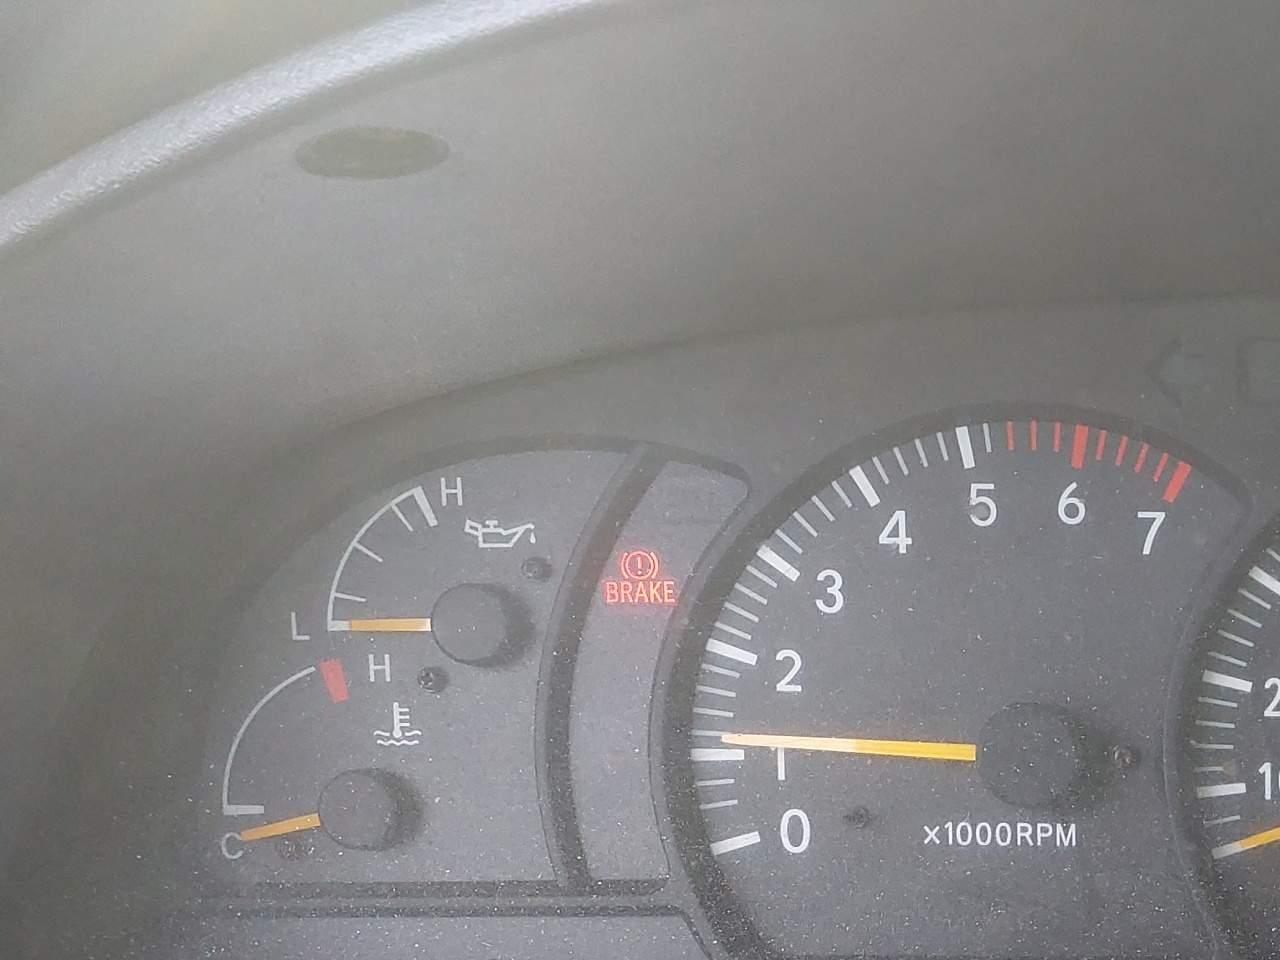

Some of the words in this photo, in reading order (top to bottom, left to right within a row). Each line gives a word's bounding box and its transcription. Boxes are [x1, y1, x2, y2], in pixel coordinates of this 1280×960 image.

[440, 476, 463, 507] H
[969, 483, 997, 527] 5
[1057, 482, 1086, 525] 6
[878, 510, 913, 554] 4
[1137, 511, 1166, 555] 7
[605, 580, 676, 604] BRAKE
[815, 569, 844, 614] 3
[290, 611, 311, 641] L
[368, 653, 391, 682] H
[775, 649, 802, 692] 2
[221, 831, 244, 860] C
[780, 808, 811, 854] 0
